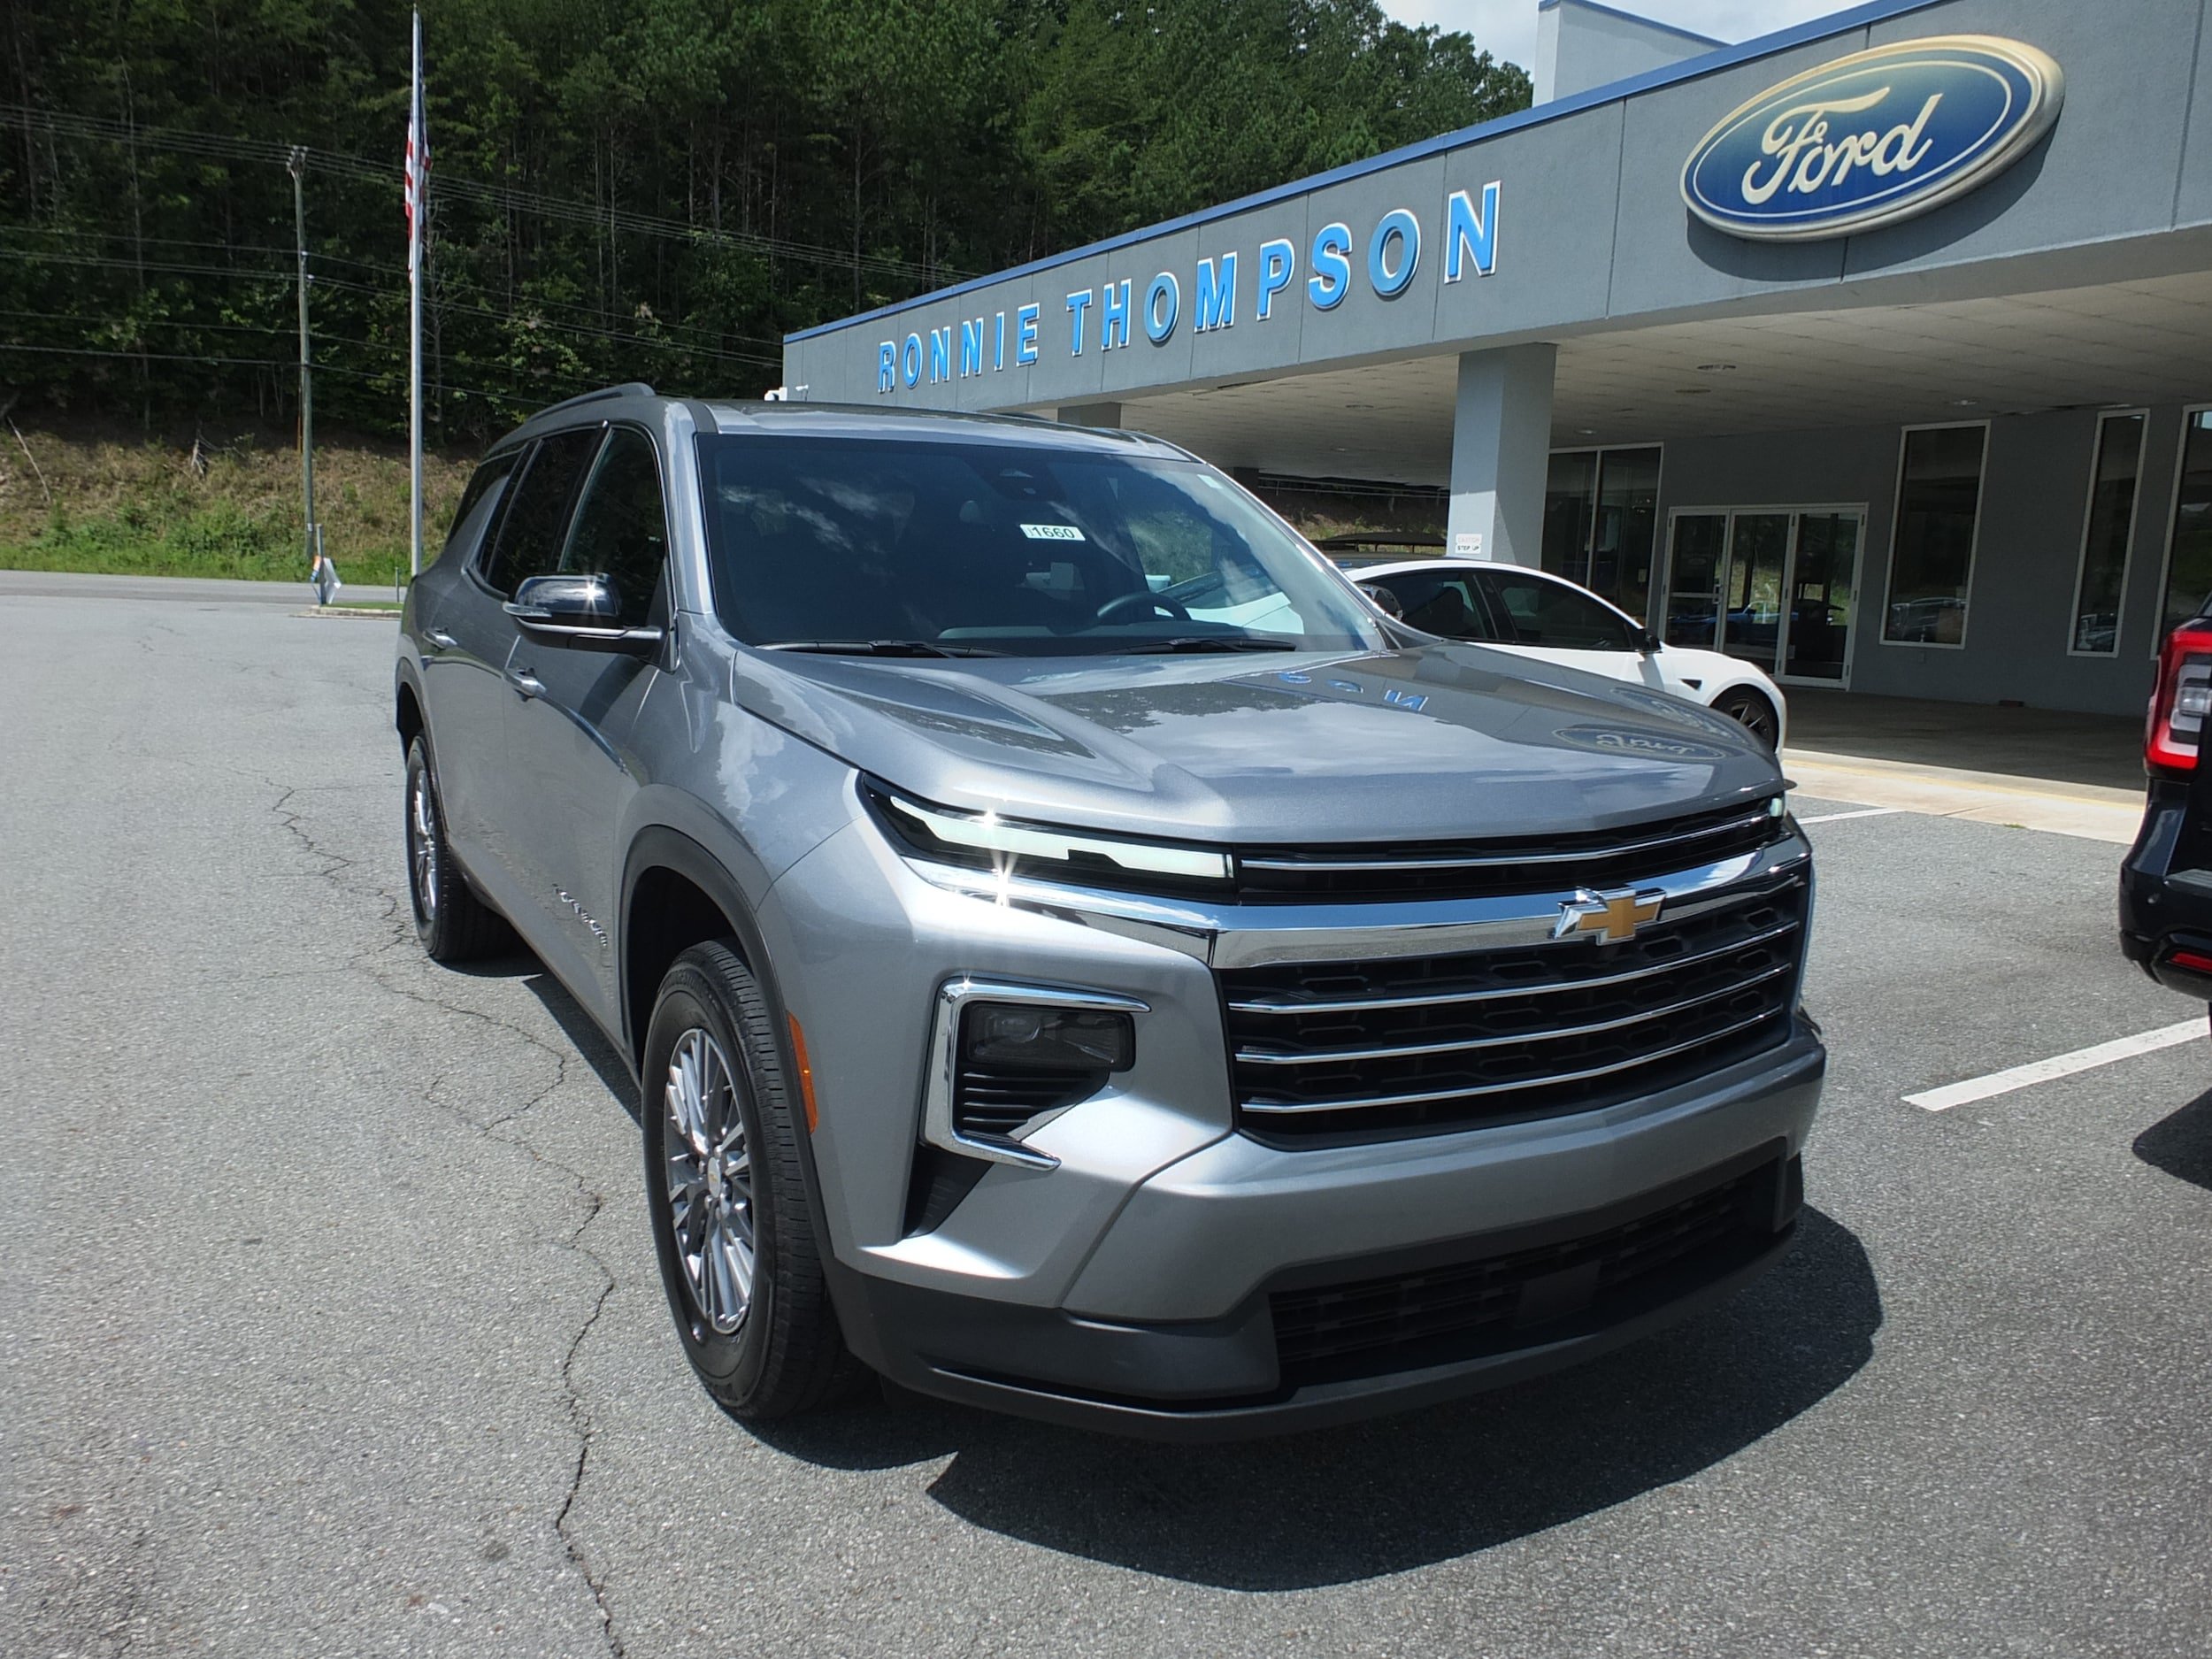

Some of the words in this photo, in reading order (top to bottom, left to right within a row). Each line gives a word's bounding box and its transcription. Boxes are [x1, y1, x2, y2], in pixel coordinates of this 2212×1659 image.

[1741, 87, 1943, 204] Ford
[878, 302, 1041, 393] RONNIE
[1065, 180, 1502, 357] THOMPSON
[1032, 526, 1076, 539] 1660
